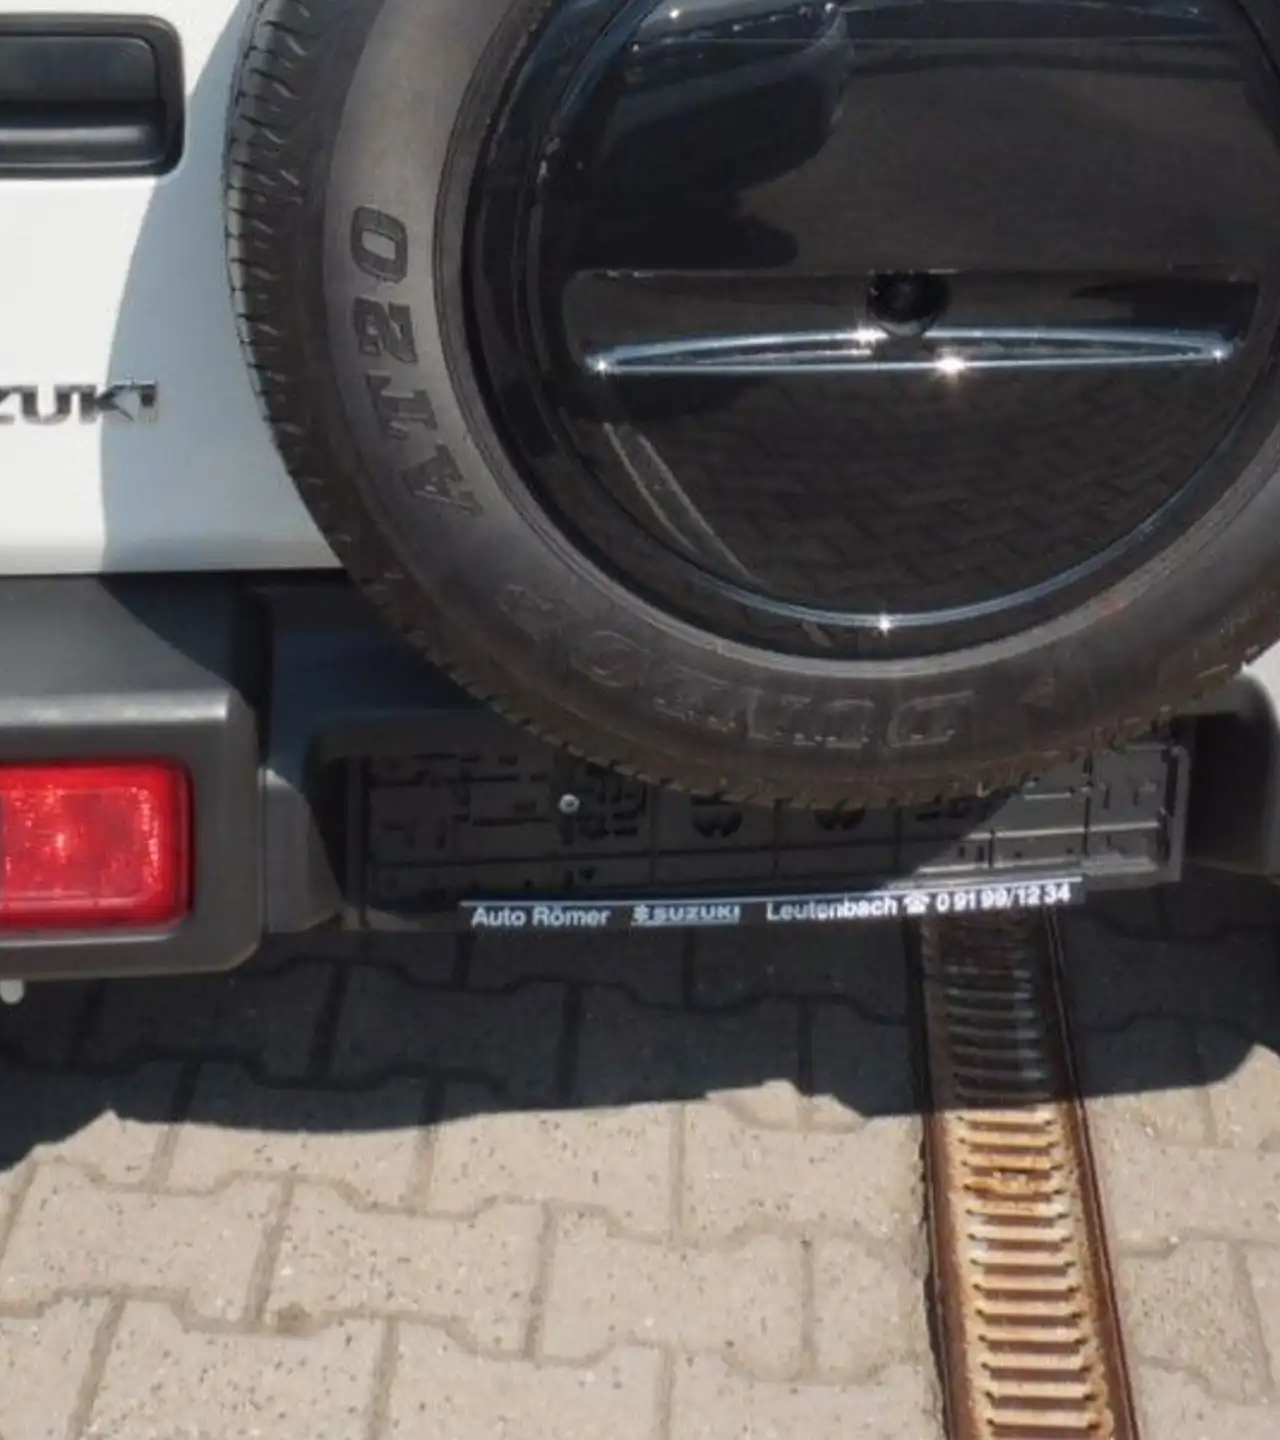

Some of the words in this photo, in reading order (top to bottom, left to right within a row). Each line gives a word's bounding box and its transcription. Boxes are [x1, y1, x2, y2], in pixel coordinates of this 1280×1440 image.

[349, 204, 484, 516] AT20
[471, 906, 526, 927] Auto
[531, 903, 610, 928] Römer
[653, 904, 740, 922] SUZUKI
[766, 896, 898, 921] Leutenbach
